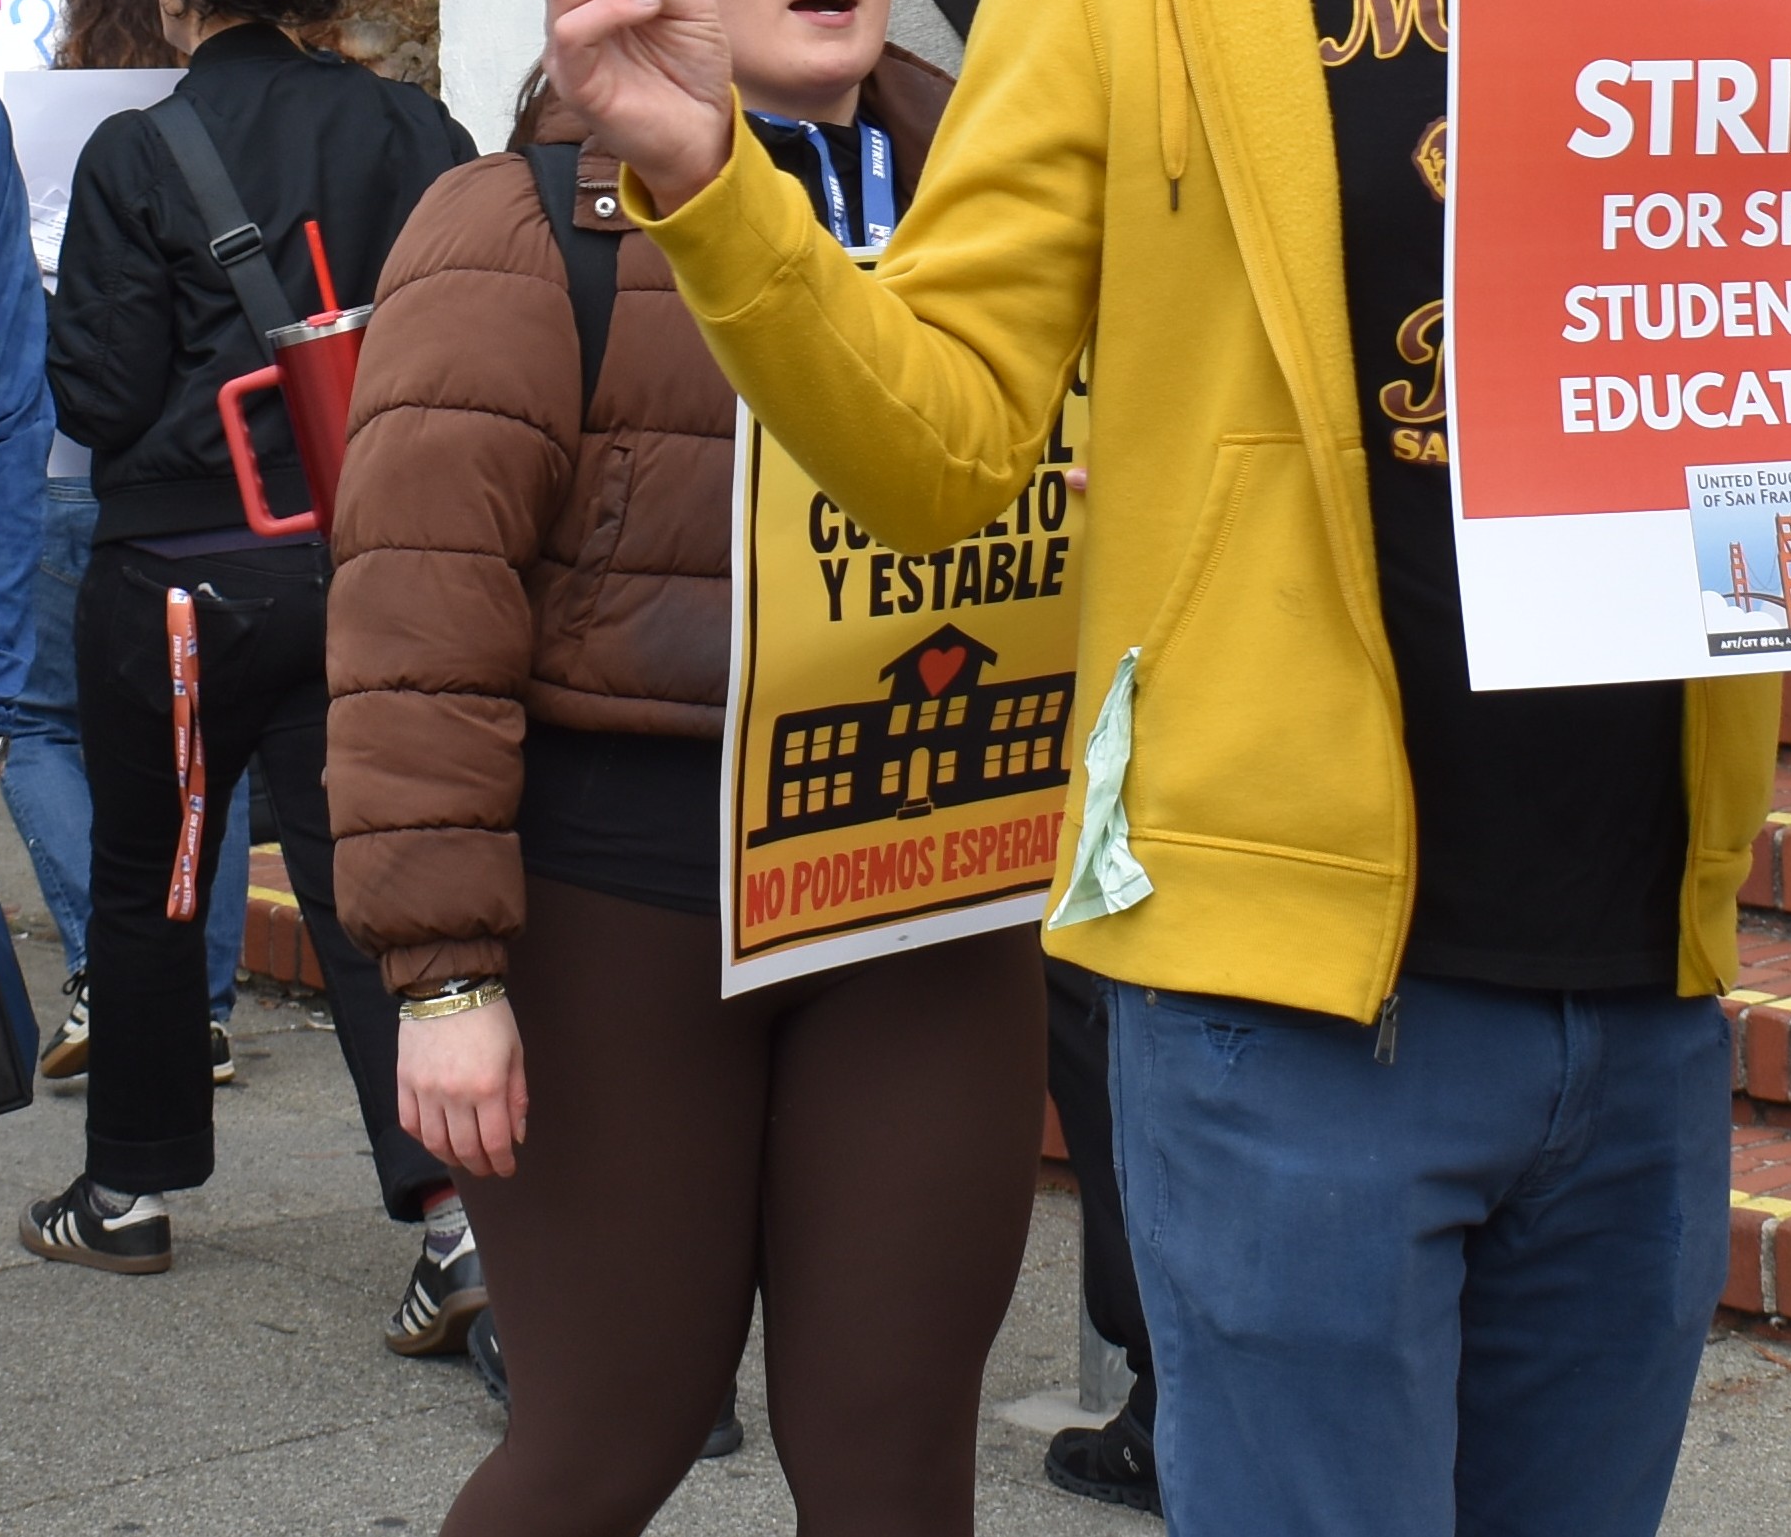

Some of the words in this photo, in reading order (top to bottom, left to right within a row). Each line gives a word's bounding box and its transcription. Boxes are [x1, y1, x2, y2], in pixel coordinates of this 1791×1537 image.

[871, 138, 886, 179] STRIKE
[1602, 192, 1728, 250] FOR
[819, 557, 849, 622] Y
[868, 536, 1070, 618] ESTABLE
[744, 865, 785, 928] NO
[791, 834, 935, 923] PODEMOS
